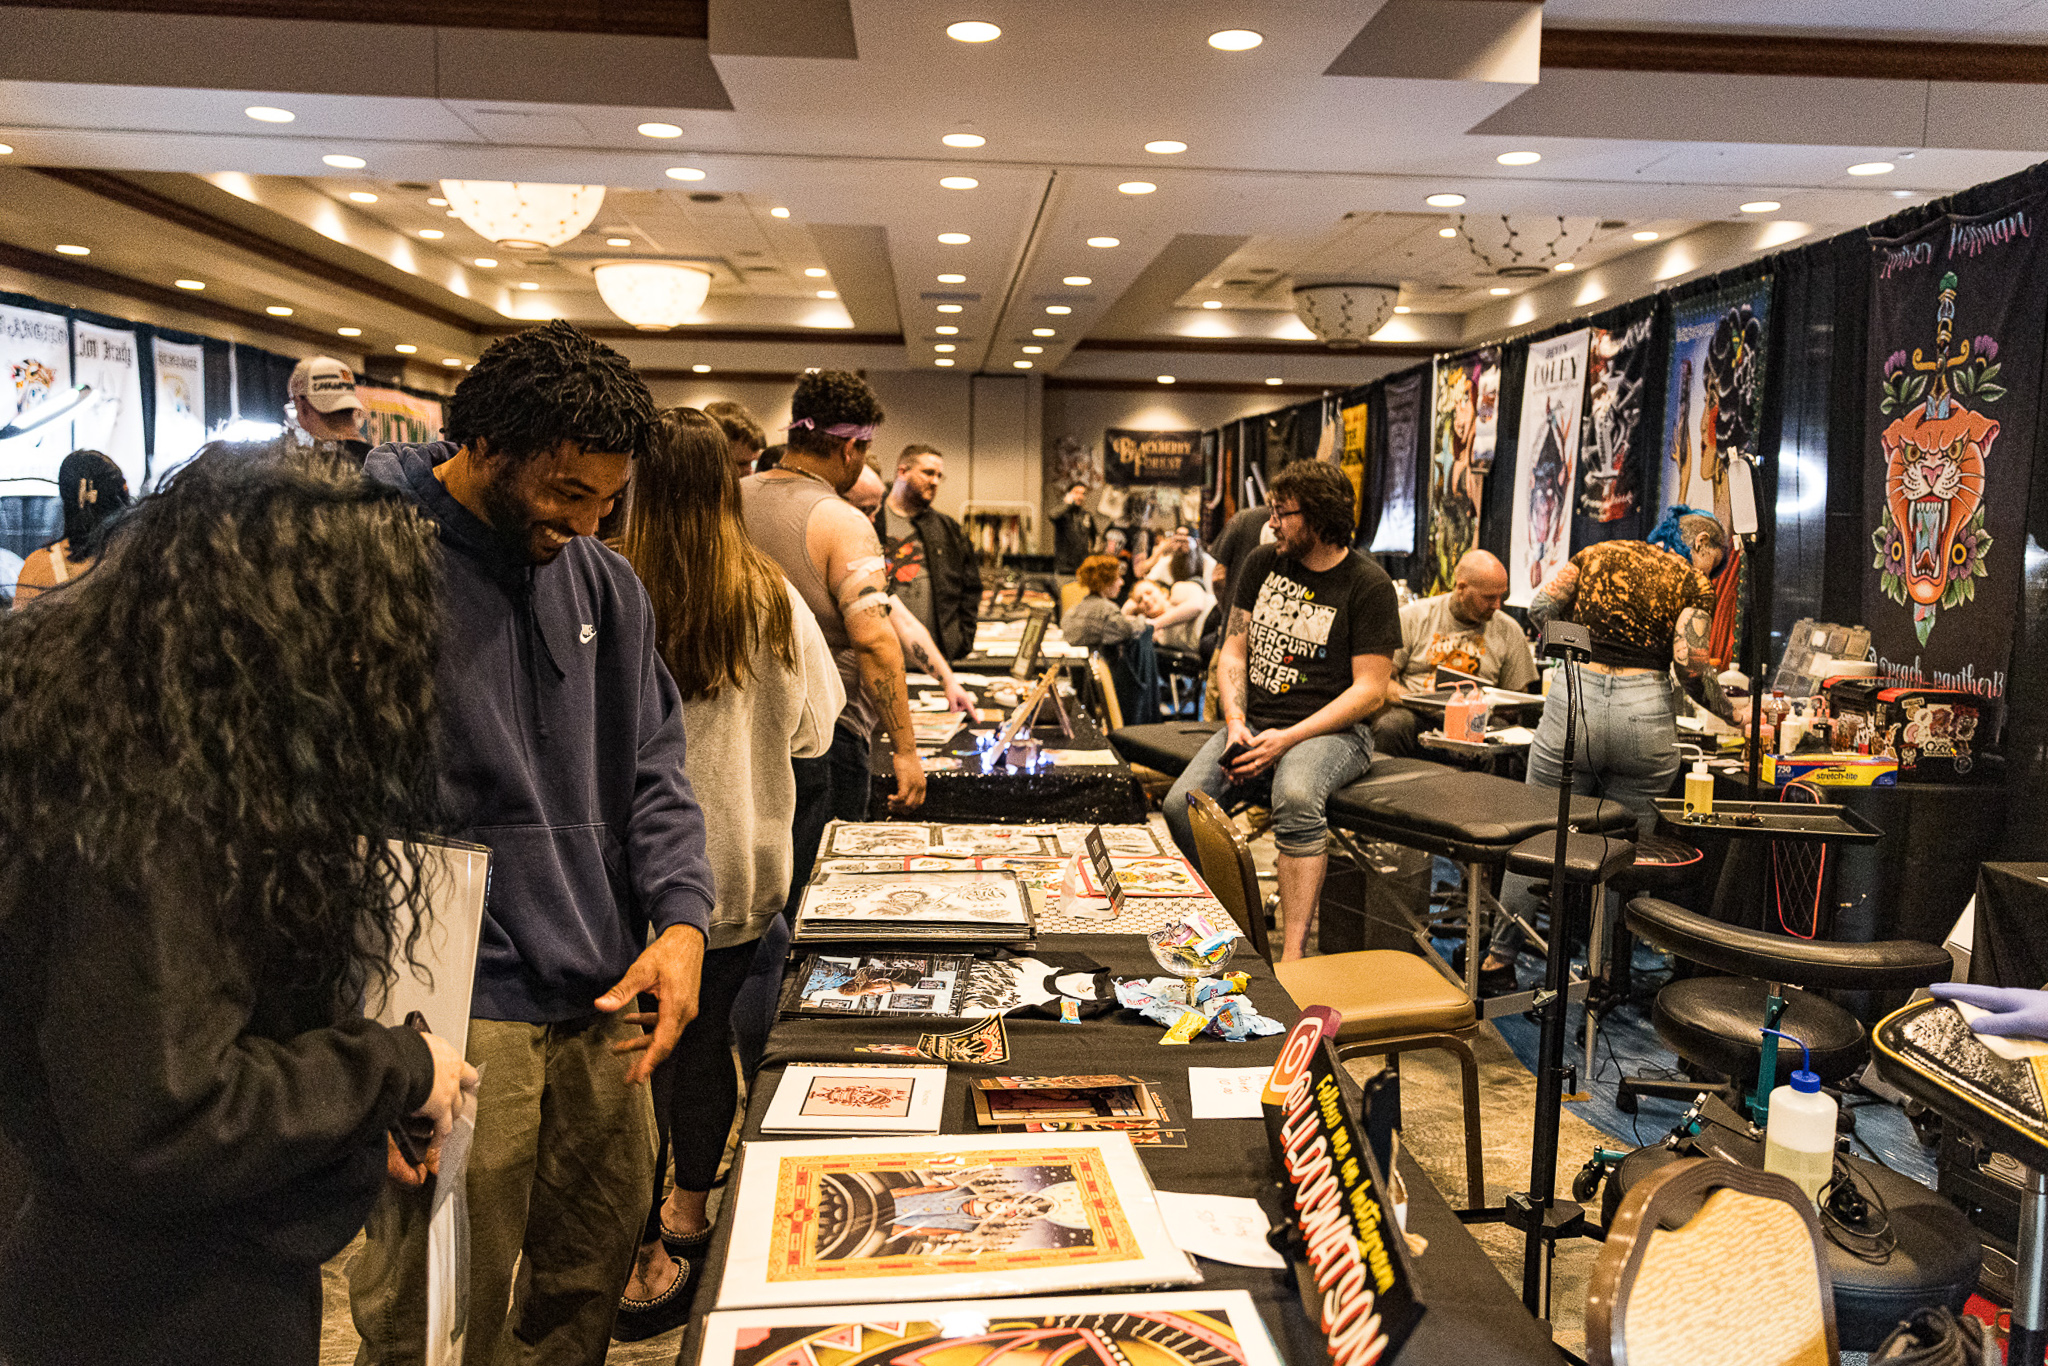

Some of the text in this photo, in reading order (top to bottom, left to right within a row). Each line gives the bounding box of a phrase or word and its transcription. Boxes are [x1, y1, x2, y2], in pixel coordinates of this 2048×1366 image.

[1264, 571, 1306, 600] MOON
[1776, 765, 1792, 774] 750
[1349, 1179, 1396, 1295] Instagram
